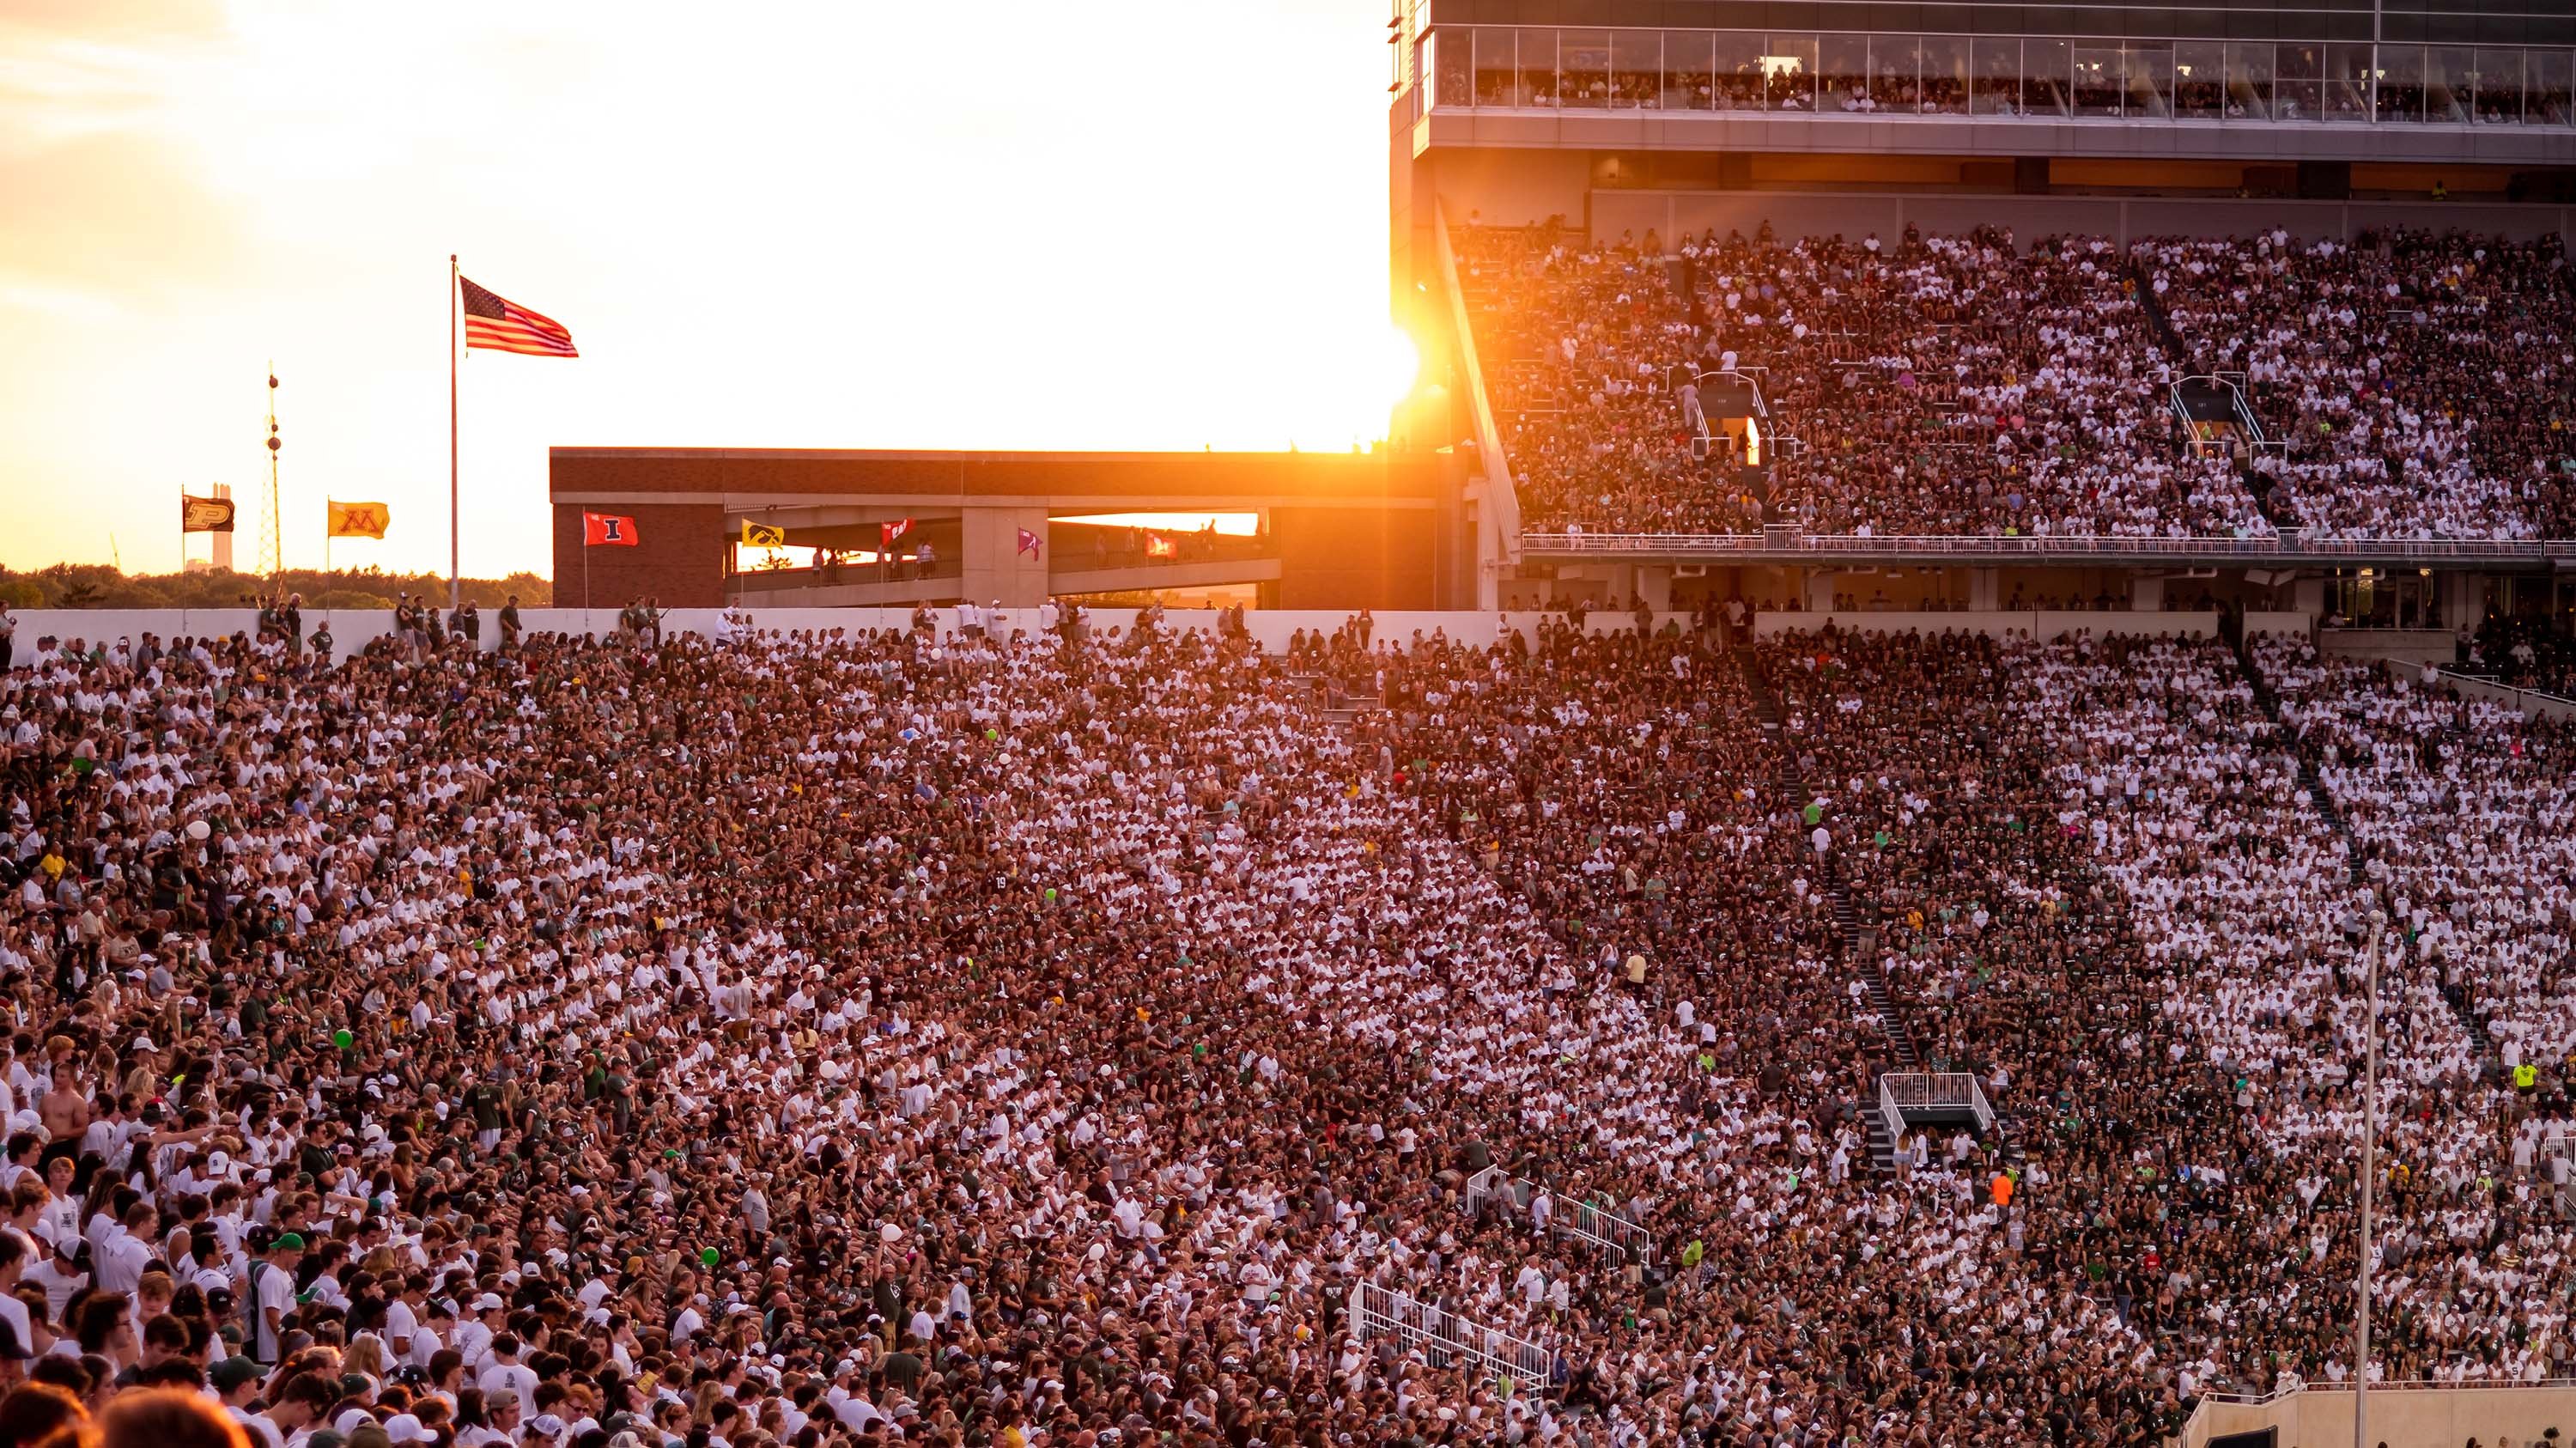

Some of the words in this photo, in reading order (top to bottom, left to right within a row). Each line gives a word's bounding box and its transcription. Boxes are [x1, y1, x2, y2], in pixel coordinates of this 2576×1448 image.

[185, 503, 230, 529] P
[337, 508, 381, 534] M
[604, 519, 622, 541] I
[996, 876, 1006, 889] 19
[2089, 1108, 2095, 1117] 9
[2512, 1366, 2519, 1376] S
